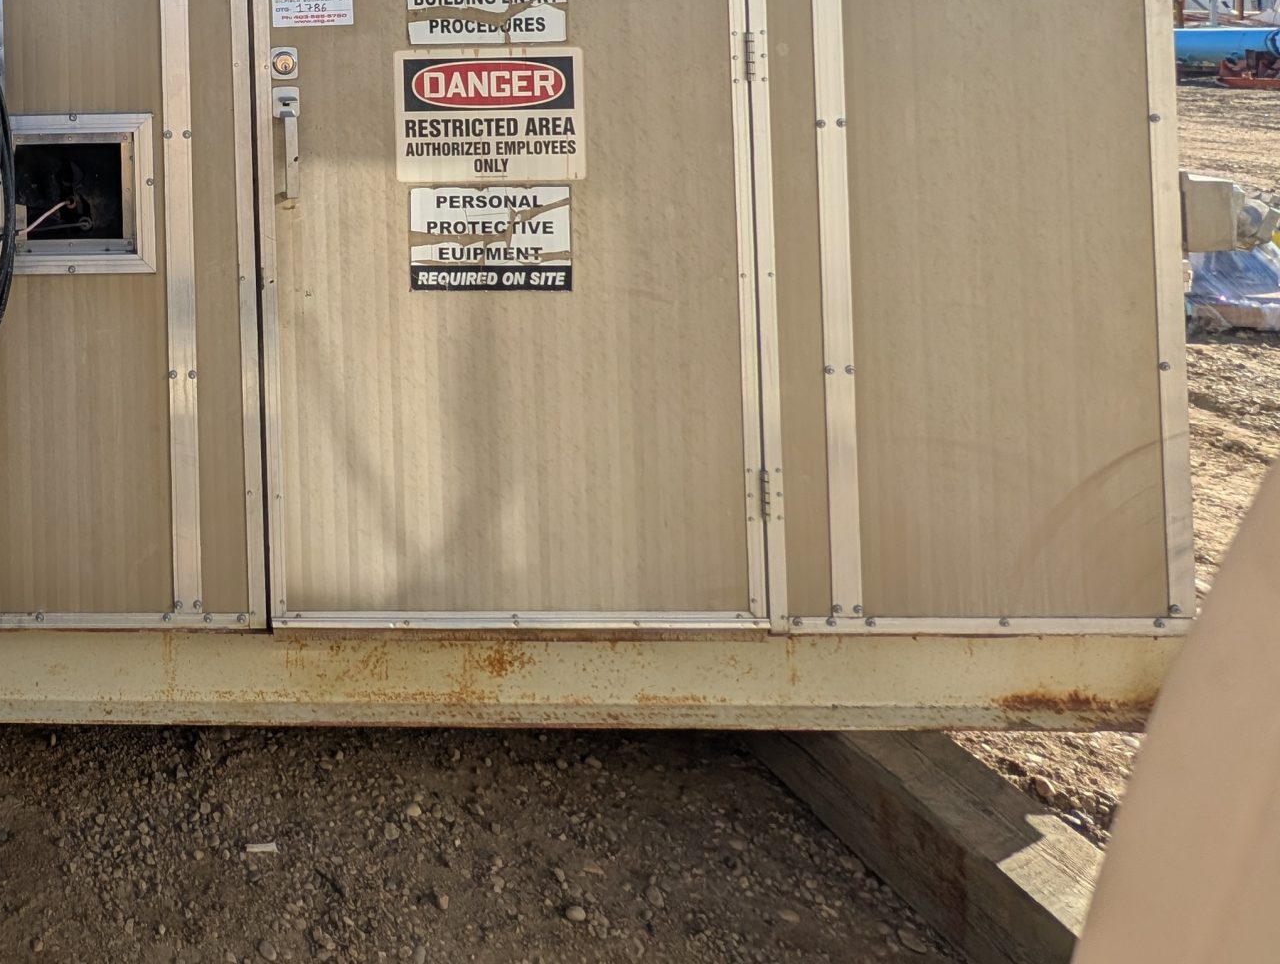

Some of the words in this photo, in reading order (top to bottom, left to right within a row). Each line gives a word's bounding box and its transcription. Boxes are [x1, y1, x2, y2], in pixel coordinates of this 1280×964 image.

[296, 2, 327, 13] 1786
[423, 70, 555, 98] DANGER
[405, 117, 518, 138] RESTRICTED
[525, 116, 576, 136] AREA
[406, 141, 491, 157] AUTHORIZED
[496, 140, 576, 155] EMPLOYEES
[474, 158, 509, 173] ONLY
[436, 194, 543, 209] PERSONAL
[427, 221, 554, 235] PROTECTIVE
[438, 246, 543, 260] EUIPMENT
[417, 271, 498, 285] REQUIRED
[502, 271, 527, 285] ON
[530, 271, 566, 285] SITE
